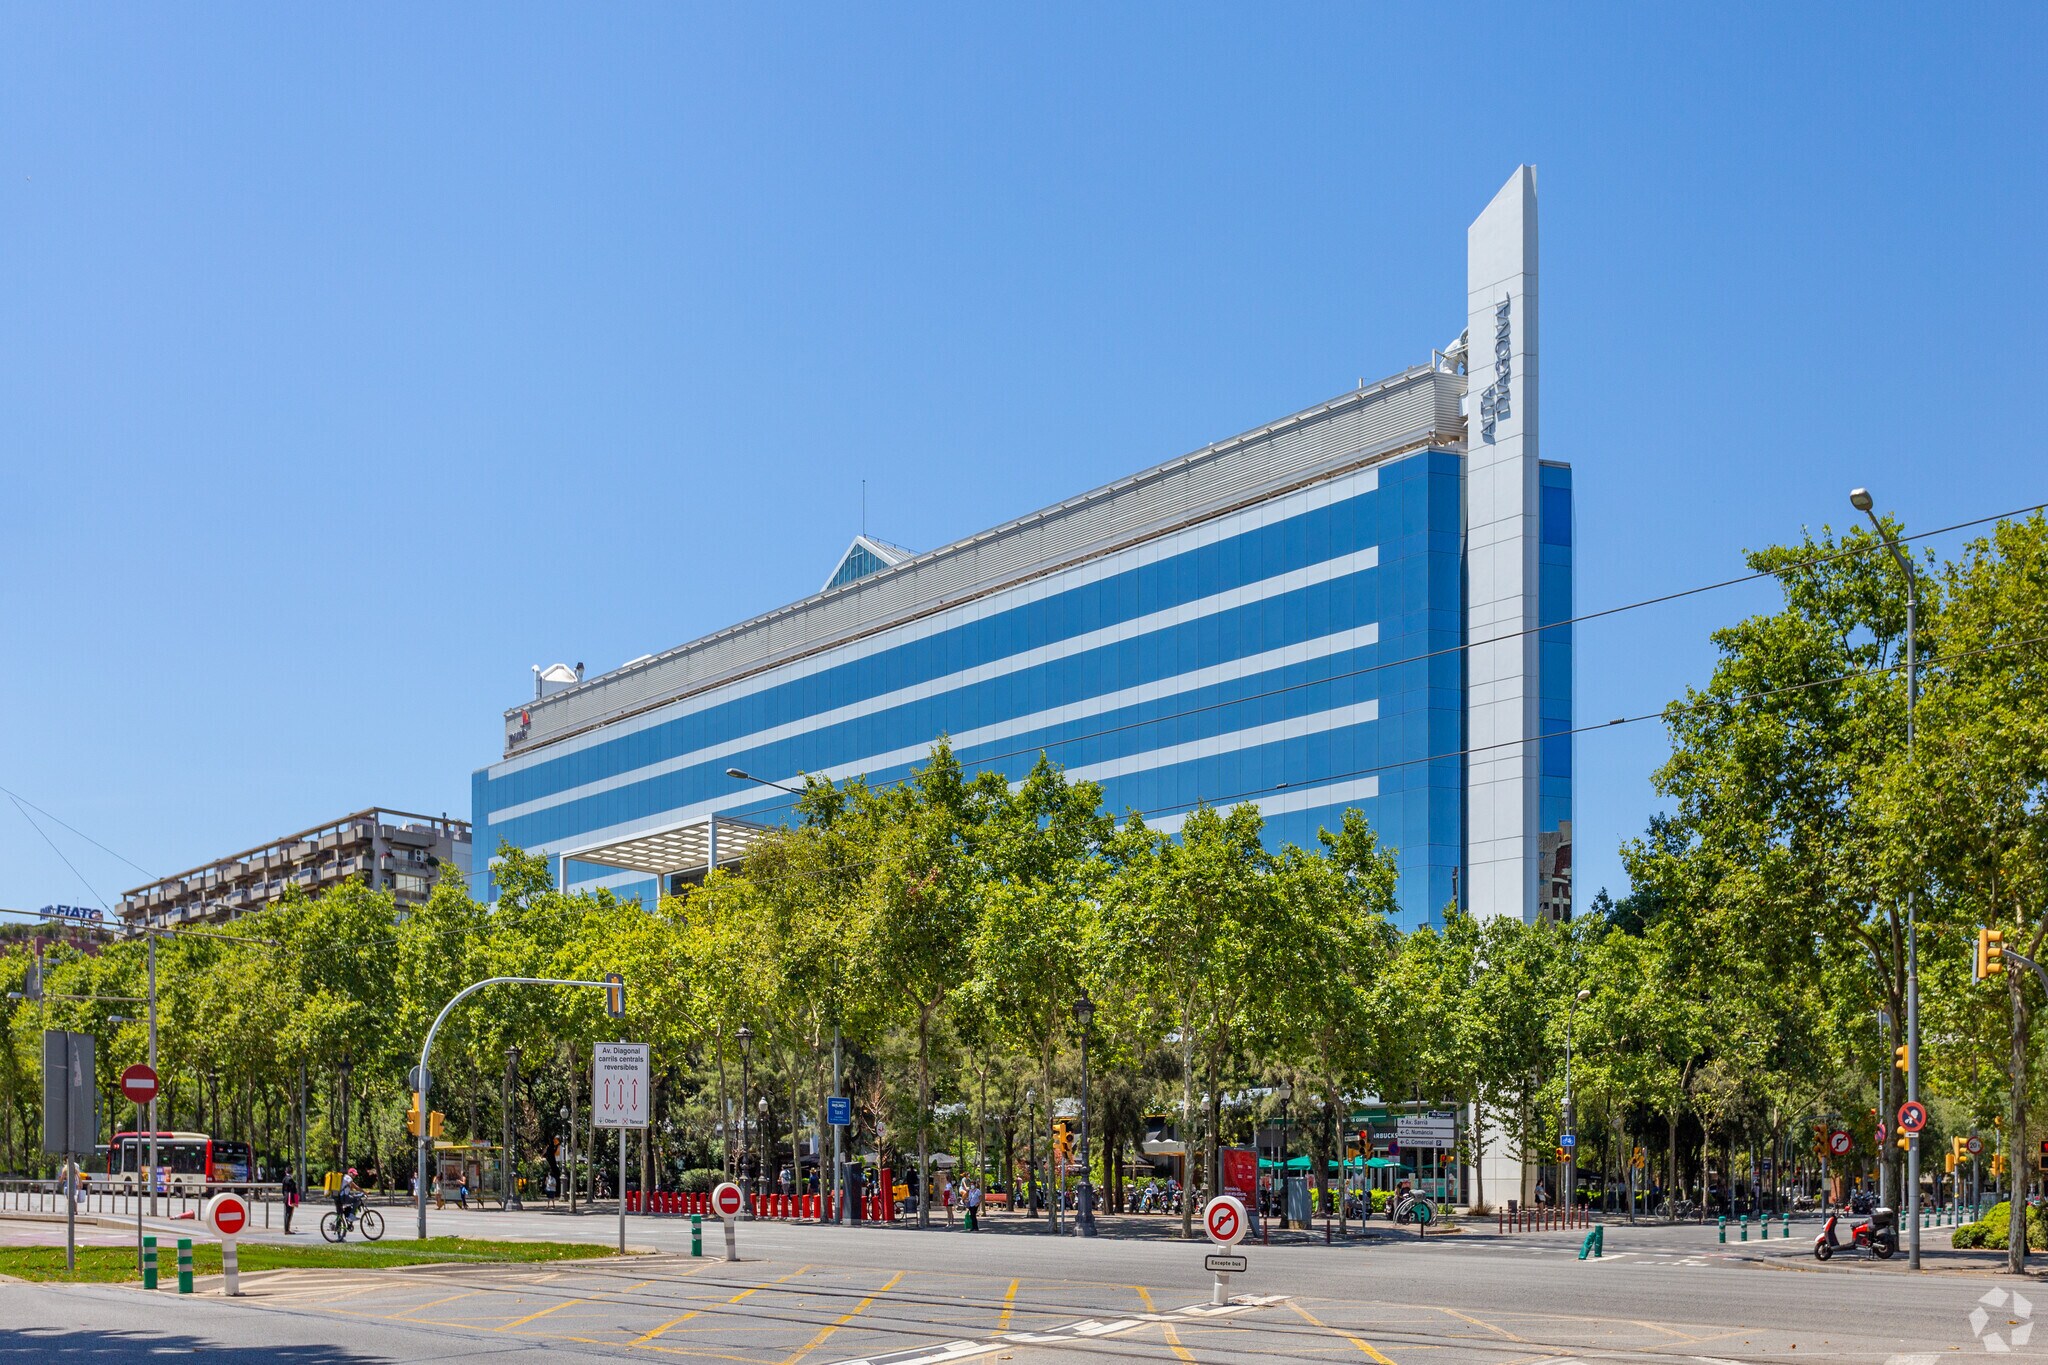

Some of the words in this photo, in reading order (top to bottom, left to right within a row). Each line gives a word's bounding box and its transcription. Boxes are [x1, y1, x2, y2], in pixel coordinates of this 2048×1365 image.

[1495, 291, 1511, 416] DIAGONAL
[1480, 384, 1496, 439] ALTA
[613, 1047, 641, 1055] Diagonal
